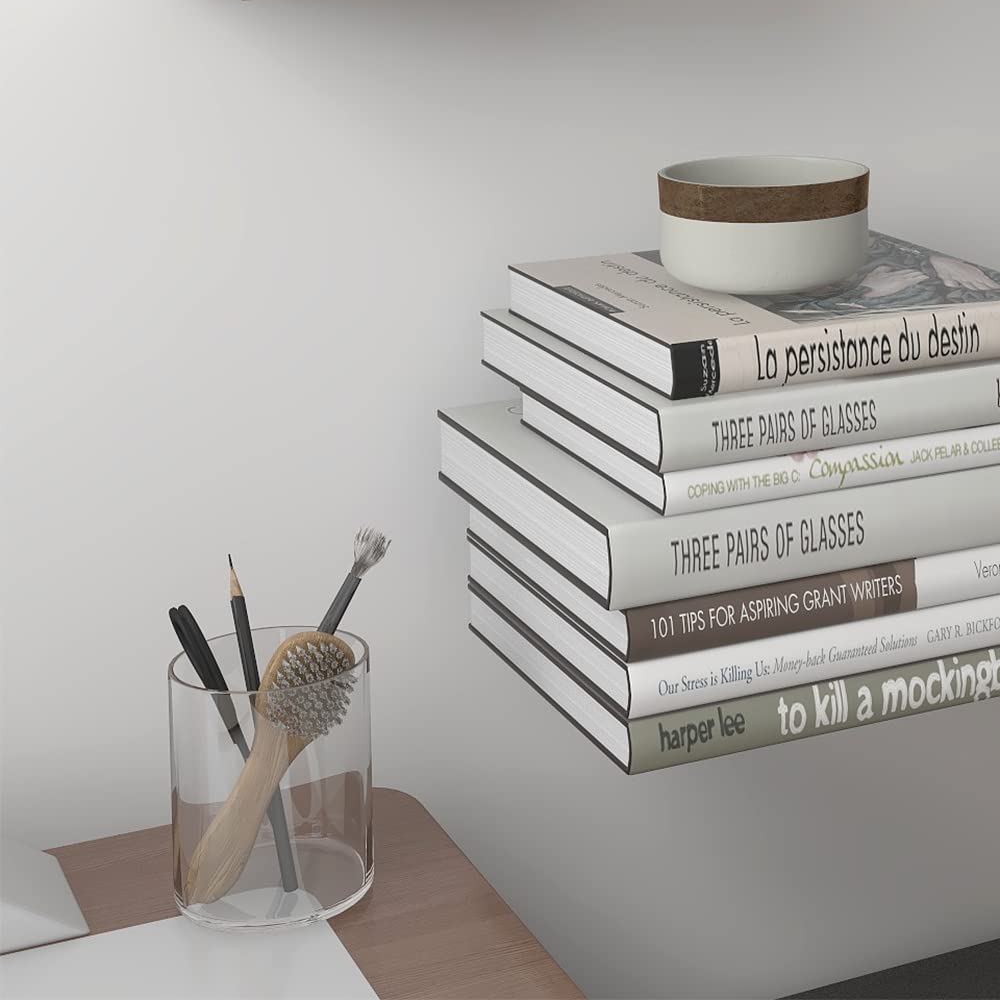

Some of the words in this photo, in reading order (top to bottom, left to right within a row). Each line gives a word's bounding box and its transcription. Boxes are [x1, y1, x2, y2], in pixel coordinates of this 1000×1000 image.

[753, 334, 778, 382] La
[781, 327, 892, 387] persistance
[899, 316, 921, 363] du
[928, 311, 981, 359] destin
[712, 416, 755, 453] THREE
[758, 410, 796, 447] PAIRS
[801, 407, 817, 440] OF
[822, 399, 878, 438] GLASSES
[687, 483, 726, 500] COPING
[726, 476, 751, 493] WITH
[753, 473, 771, 489] THE
[773, 470, 789, 485] BIG
[791, 469, 801, 484] C:
[808, 445, 905, 489] Compassion
[910, 447, 934, 464] JACK
[934, 444, 963, 461] PELAR
[963, 444, 970, 456] &
[671, 534, 720, 577] THREE
[726, 526, 769, 568] PAIRS
[776, 522, 794, 559] OF
[800, 510, 866, 555] GLASSES
[650, 615, 676, 640] 101
[679, 610, 707, 634] TIPS
[709, 605, 736, 629] FOR
[739, 593, 800, 623] ASPIRING
[802, 584, 847, 612] GRANT
[850, 574, 903, 603] WRITERS
[926, 627, 953, 643] GARY
[954, 624, 964, 638] R.
[658, 679, 679, 696] Our
[681, 674, 708, 695] Stress
[710, 670, 719, 687] is
[720, 665, 753, 685] Killing
[755, 660, 771, 677] Us:
[773, 648, 826, 674] Money-back
[828, 637, 878, 662] Guaranteed
[880, 632, 918, 655] Solutions
[658, 719, 713, 753] harper
[717, 706, 746, 738] lee
[777, 696, 807, 736] to
[812, 678, 849, 729] kill
[856, 685, 874, 722] a
